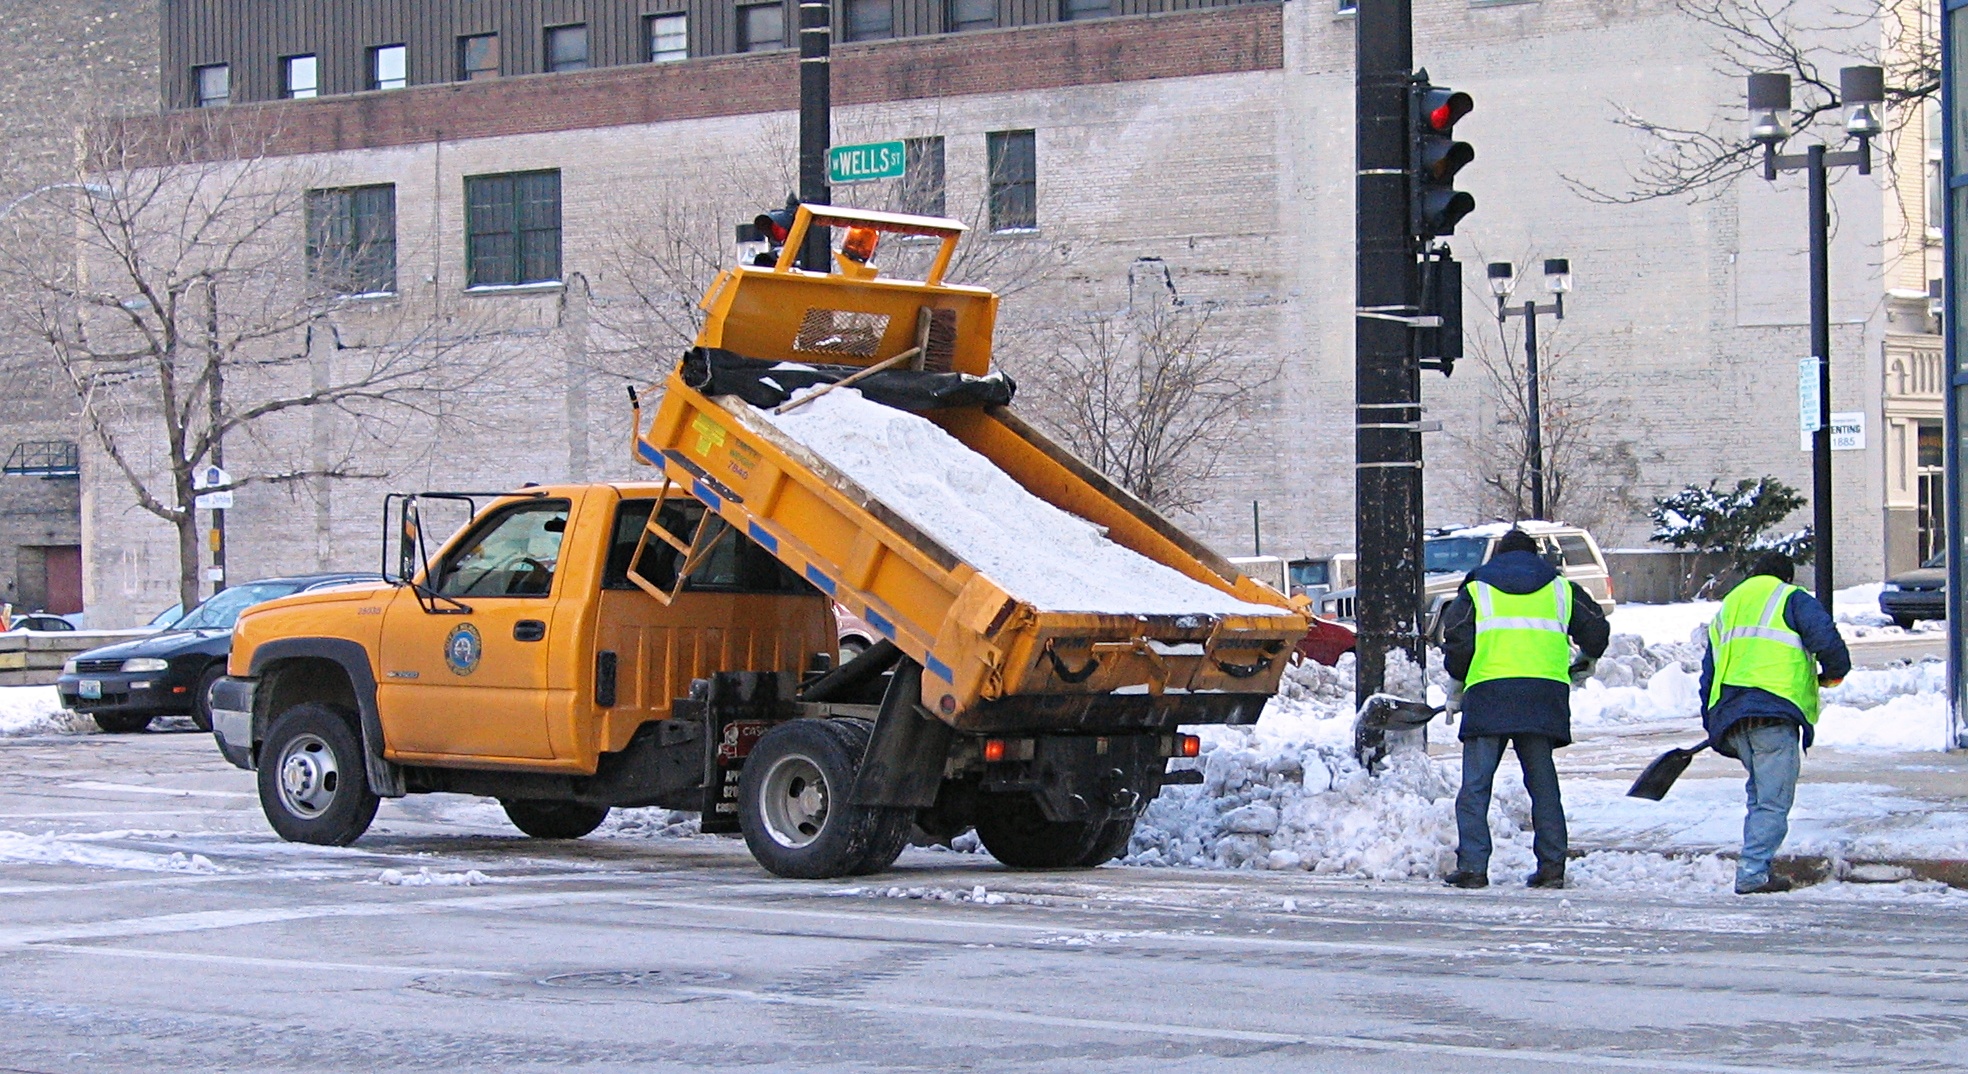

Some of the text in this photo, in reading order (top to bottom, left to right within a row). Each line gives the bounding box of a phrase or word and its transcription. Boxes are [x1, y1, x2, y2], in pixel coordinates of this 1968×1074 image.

[832, 148, 900, 176] W WELLS ST
[1830, 425, 1860, 434] ENTING
